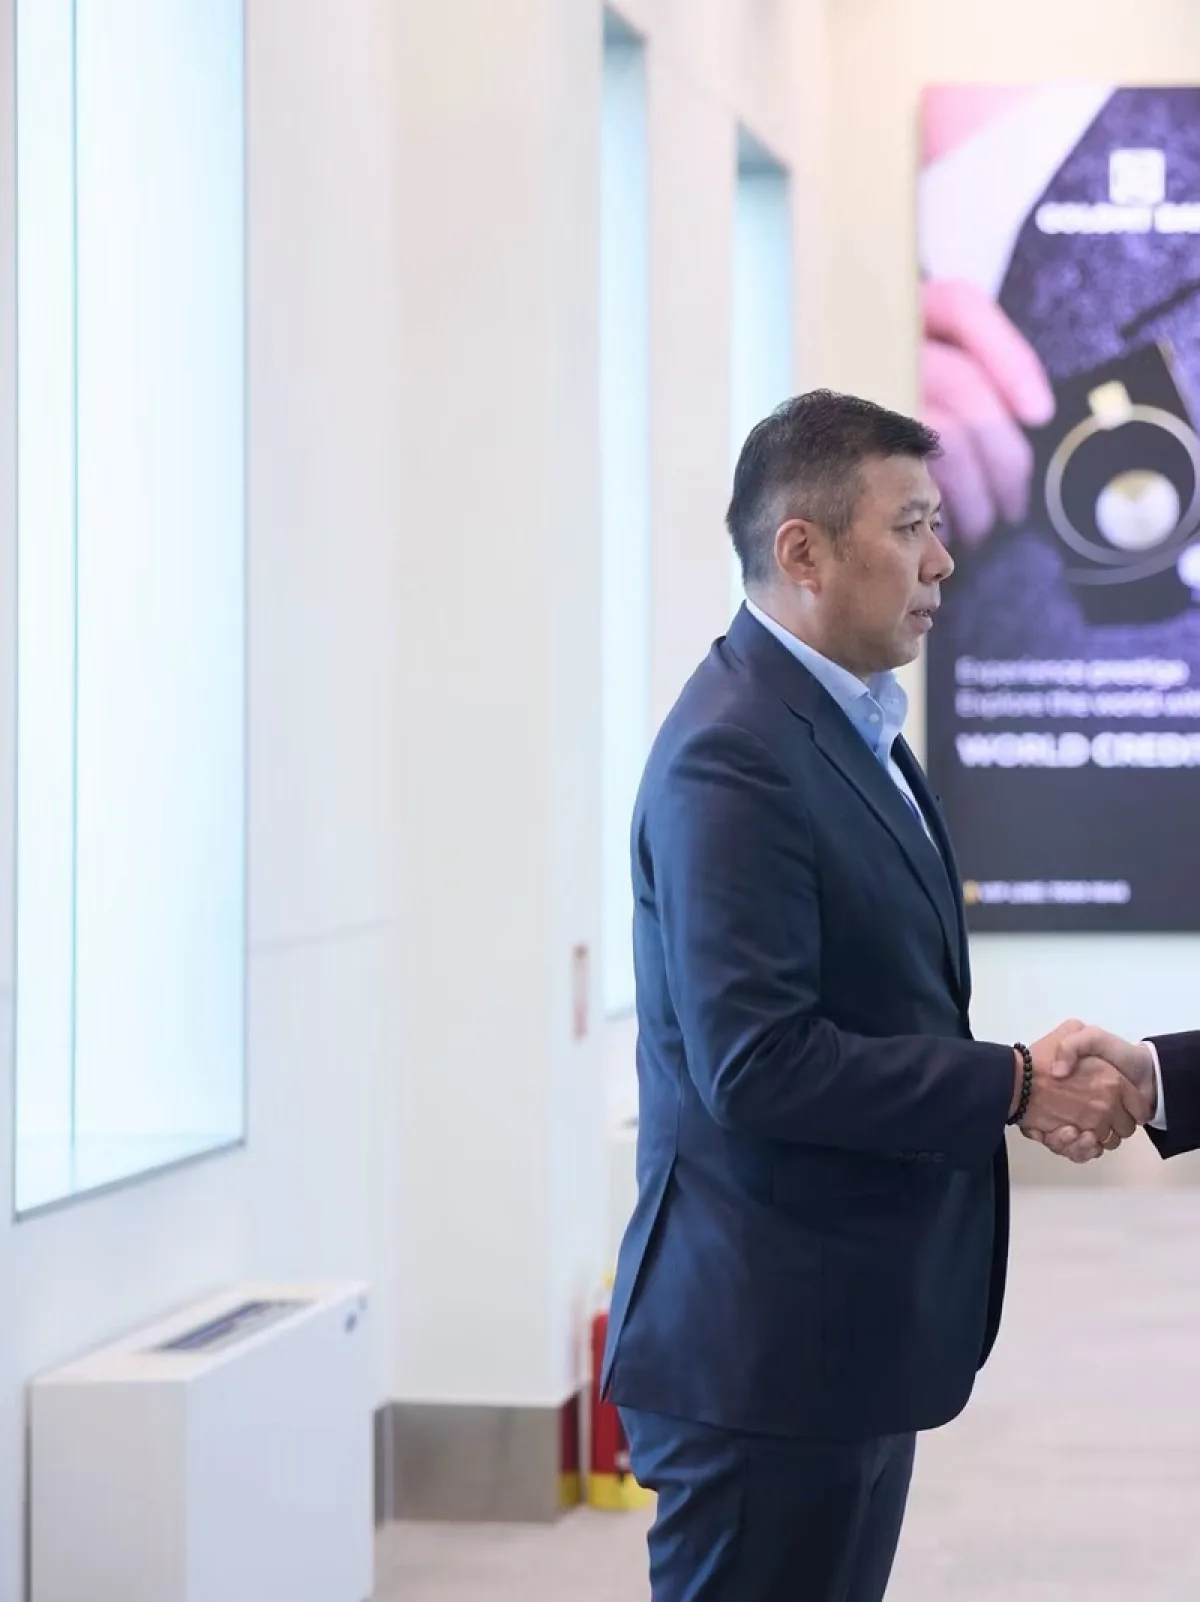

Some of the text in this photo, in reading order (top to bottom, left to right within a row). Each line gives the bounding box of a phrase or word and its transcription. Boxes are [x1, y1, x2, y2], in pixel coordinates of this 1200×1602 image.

[956, 657, 1085, 688] Experience
[955, 688, 1044, 718] Explore
[1046, 689, 1090, 717] the
[1091, 689, 1163, 717] world
[955, 732, 1090, 768] WORLD
